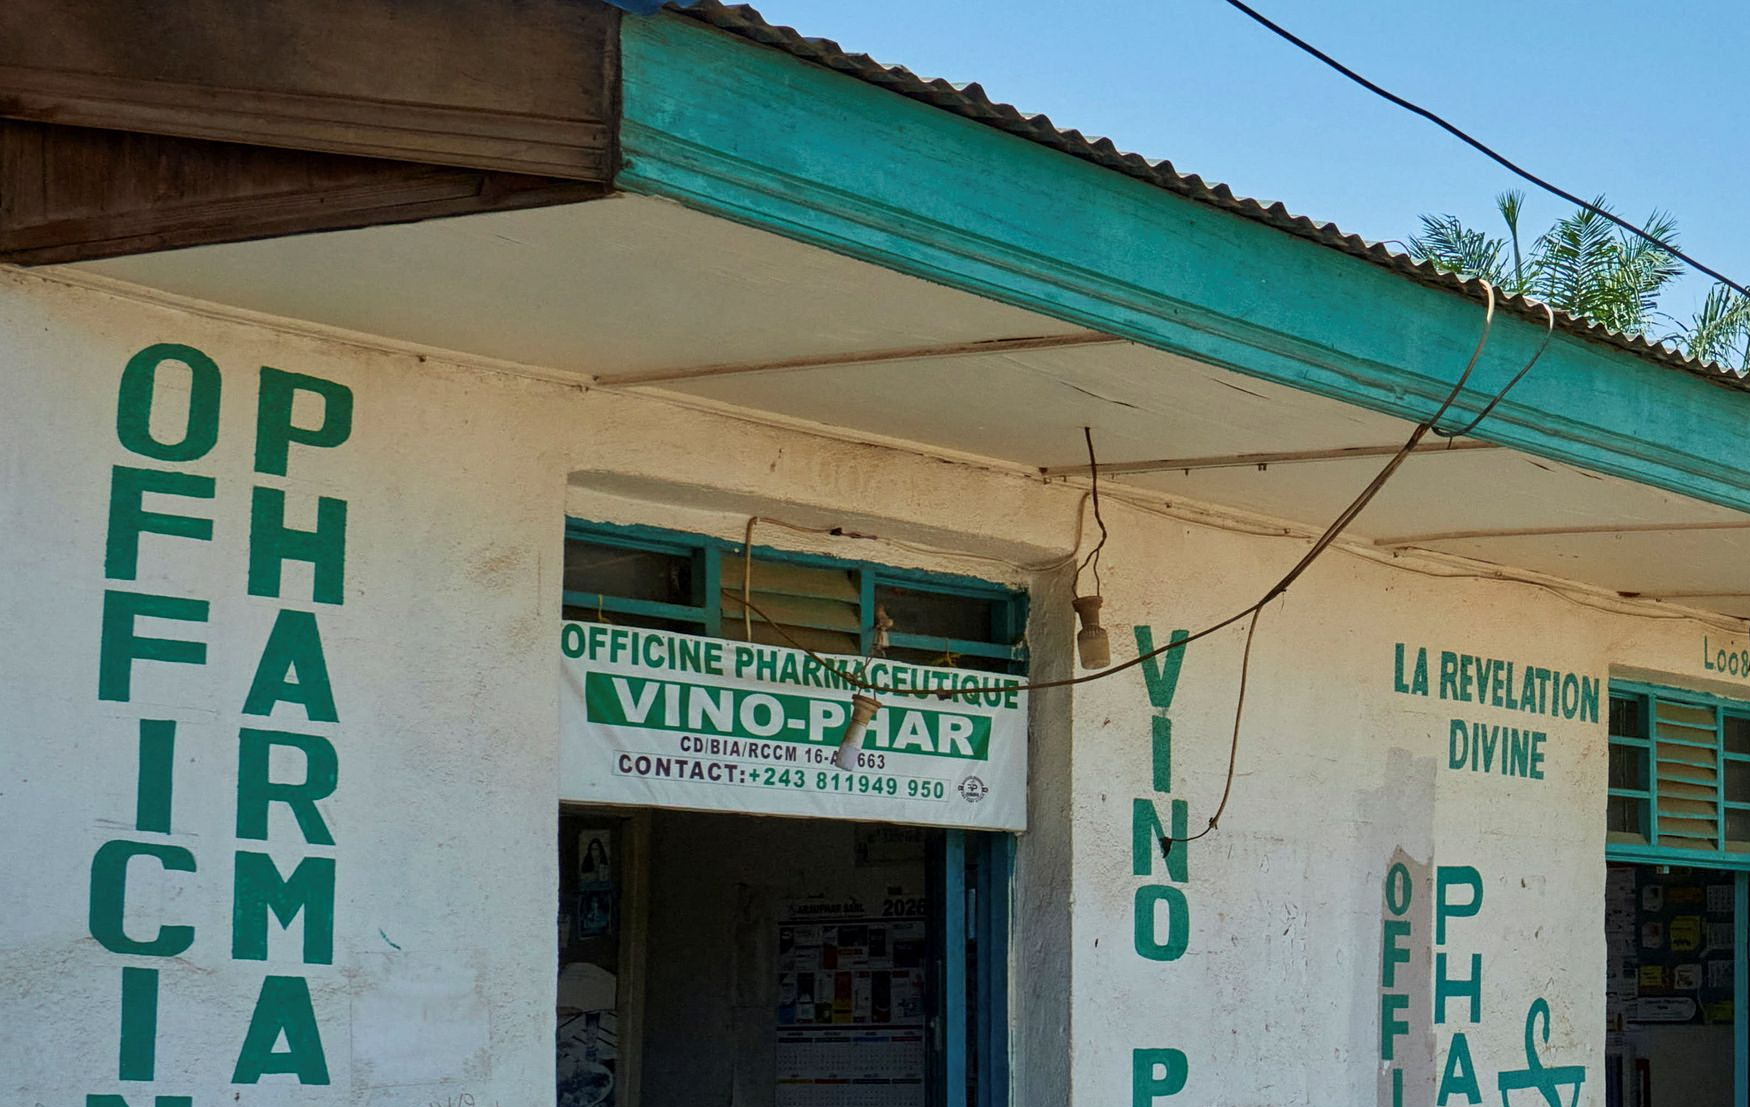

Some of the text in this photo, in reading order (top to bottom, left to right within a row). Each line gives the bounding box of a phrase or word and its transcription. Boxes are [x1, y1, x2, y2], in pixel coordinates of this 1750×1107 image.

[561, 623, 722, 675] OFFICINE
[1394, 642, 1600, 724] LA REVELATION
[229, 365, 354, 1086] PHARMA
[611, 676, 976, 757] VINO-PHAR
[680, 735, 798, 763] CD/BIA/RCCM
[1448, 718, 1548, 780] DIVINE
[816, 770, 898, 797] 811949
[907, 780, 945, 799] 950
[1132, 625, 1190, 962] VINO
